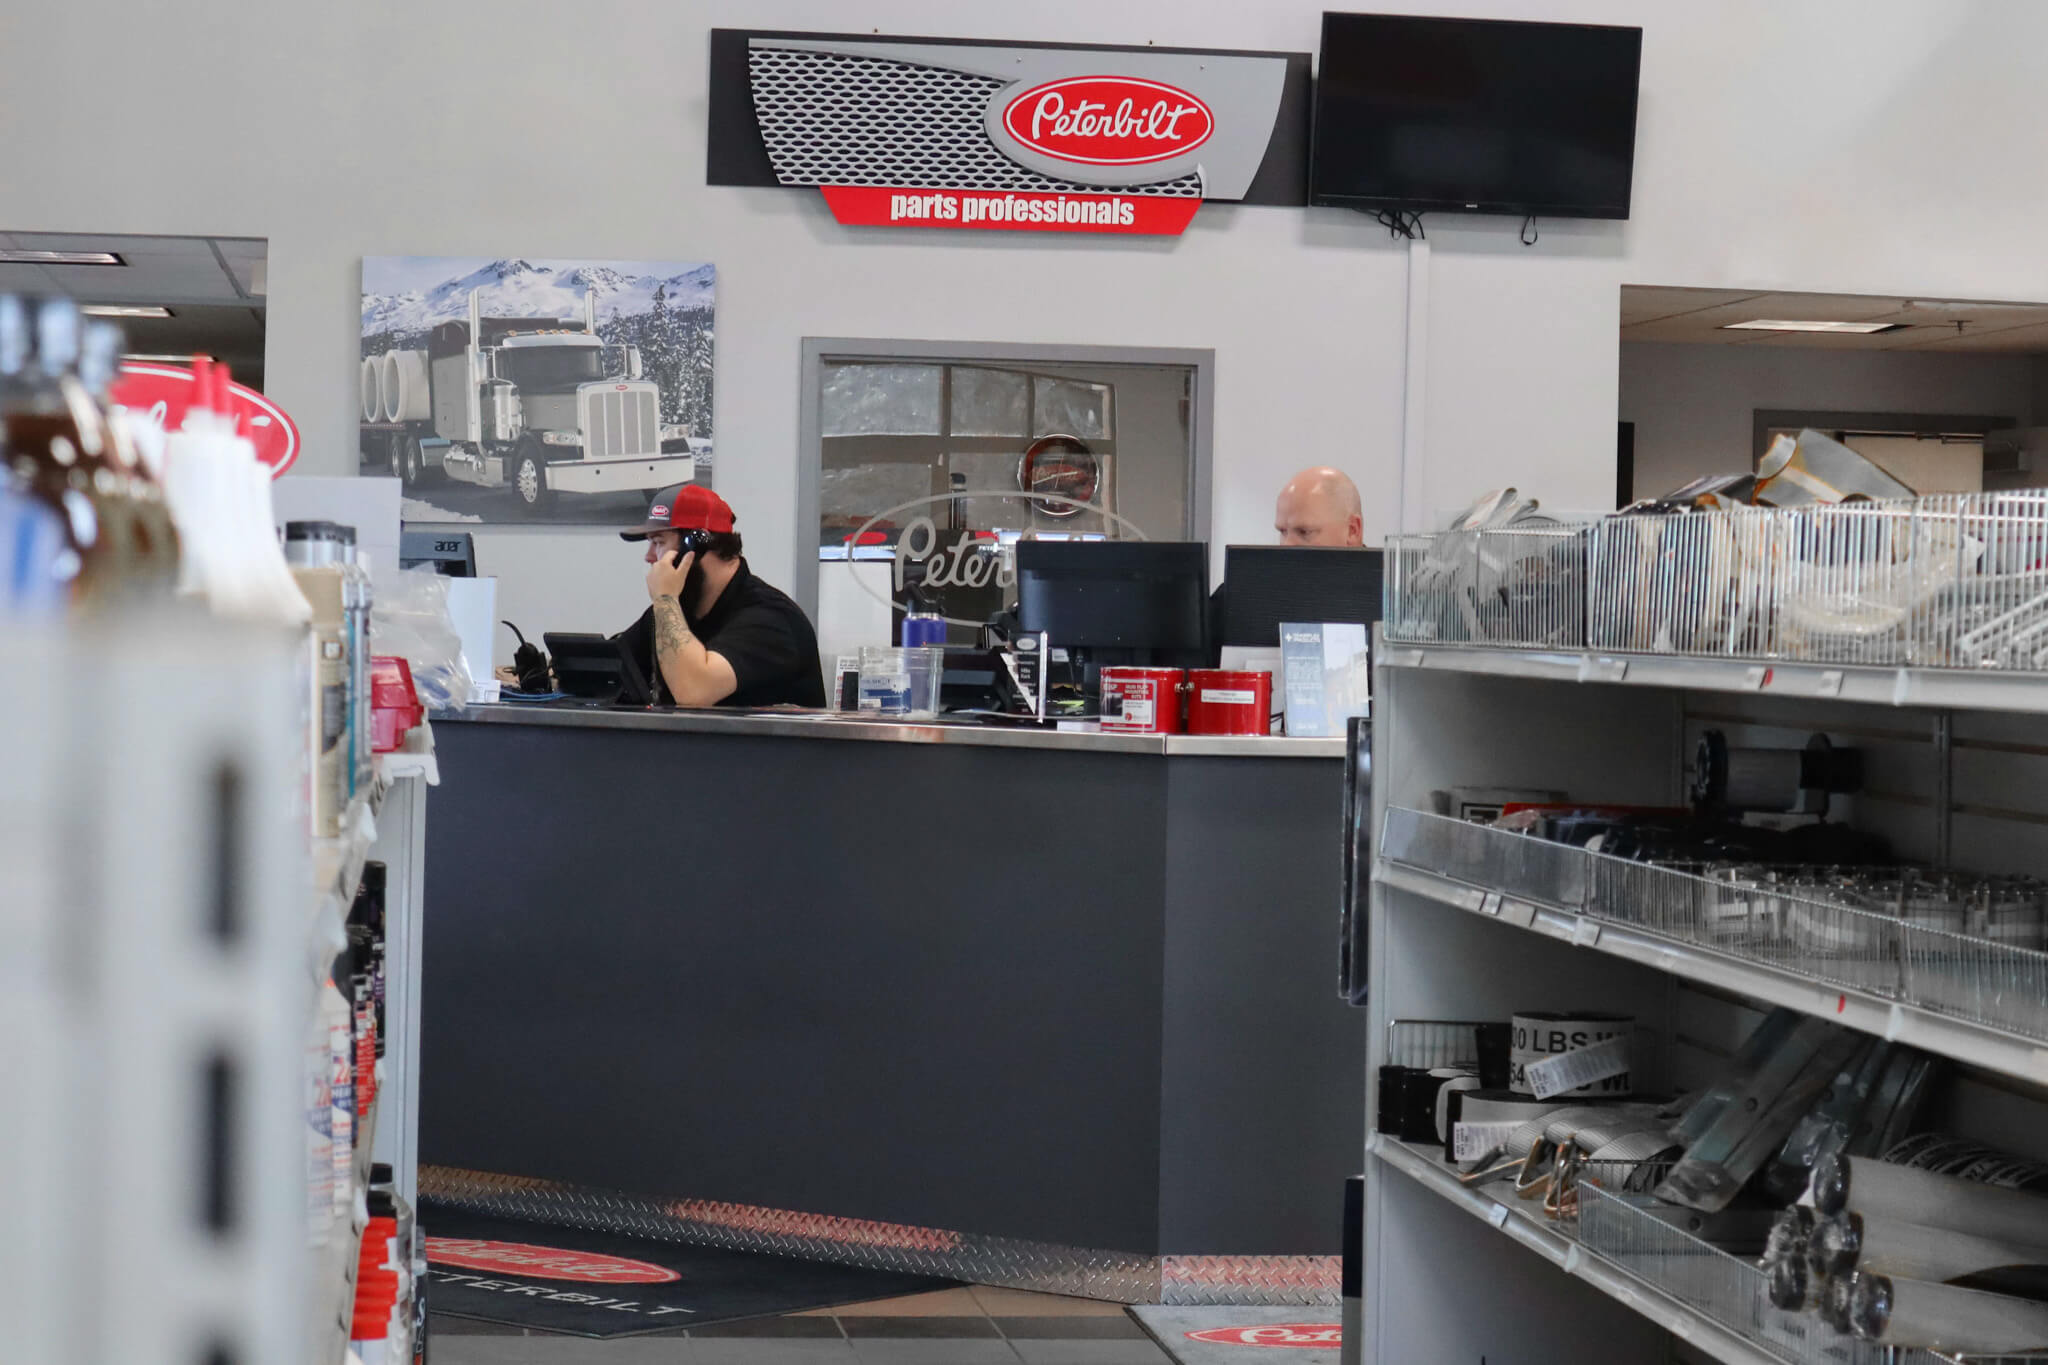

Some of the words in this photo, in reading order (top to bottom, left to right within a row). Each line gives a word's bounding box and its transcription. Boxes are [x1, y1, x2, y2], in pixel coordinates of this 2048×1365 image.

[1032, 91, 1198, 140] Peterbilt
[890, 193, 958, 221] parts
[962, 194, 1135, 225] professionals
[434, 540, 462, 552] acer
[427, 1268, 697, 1315] TERBILT
